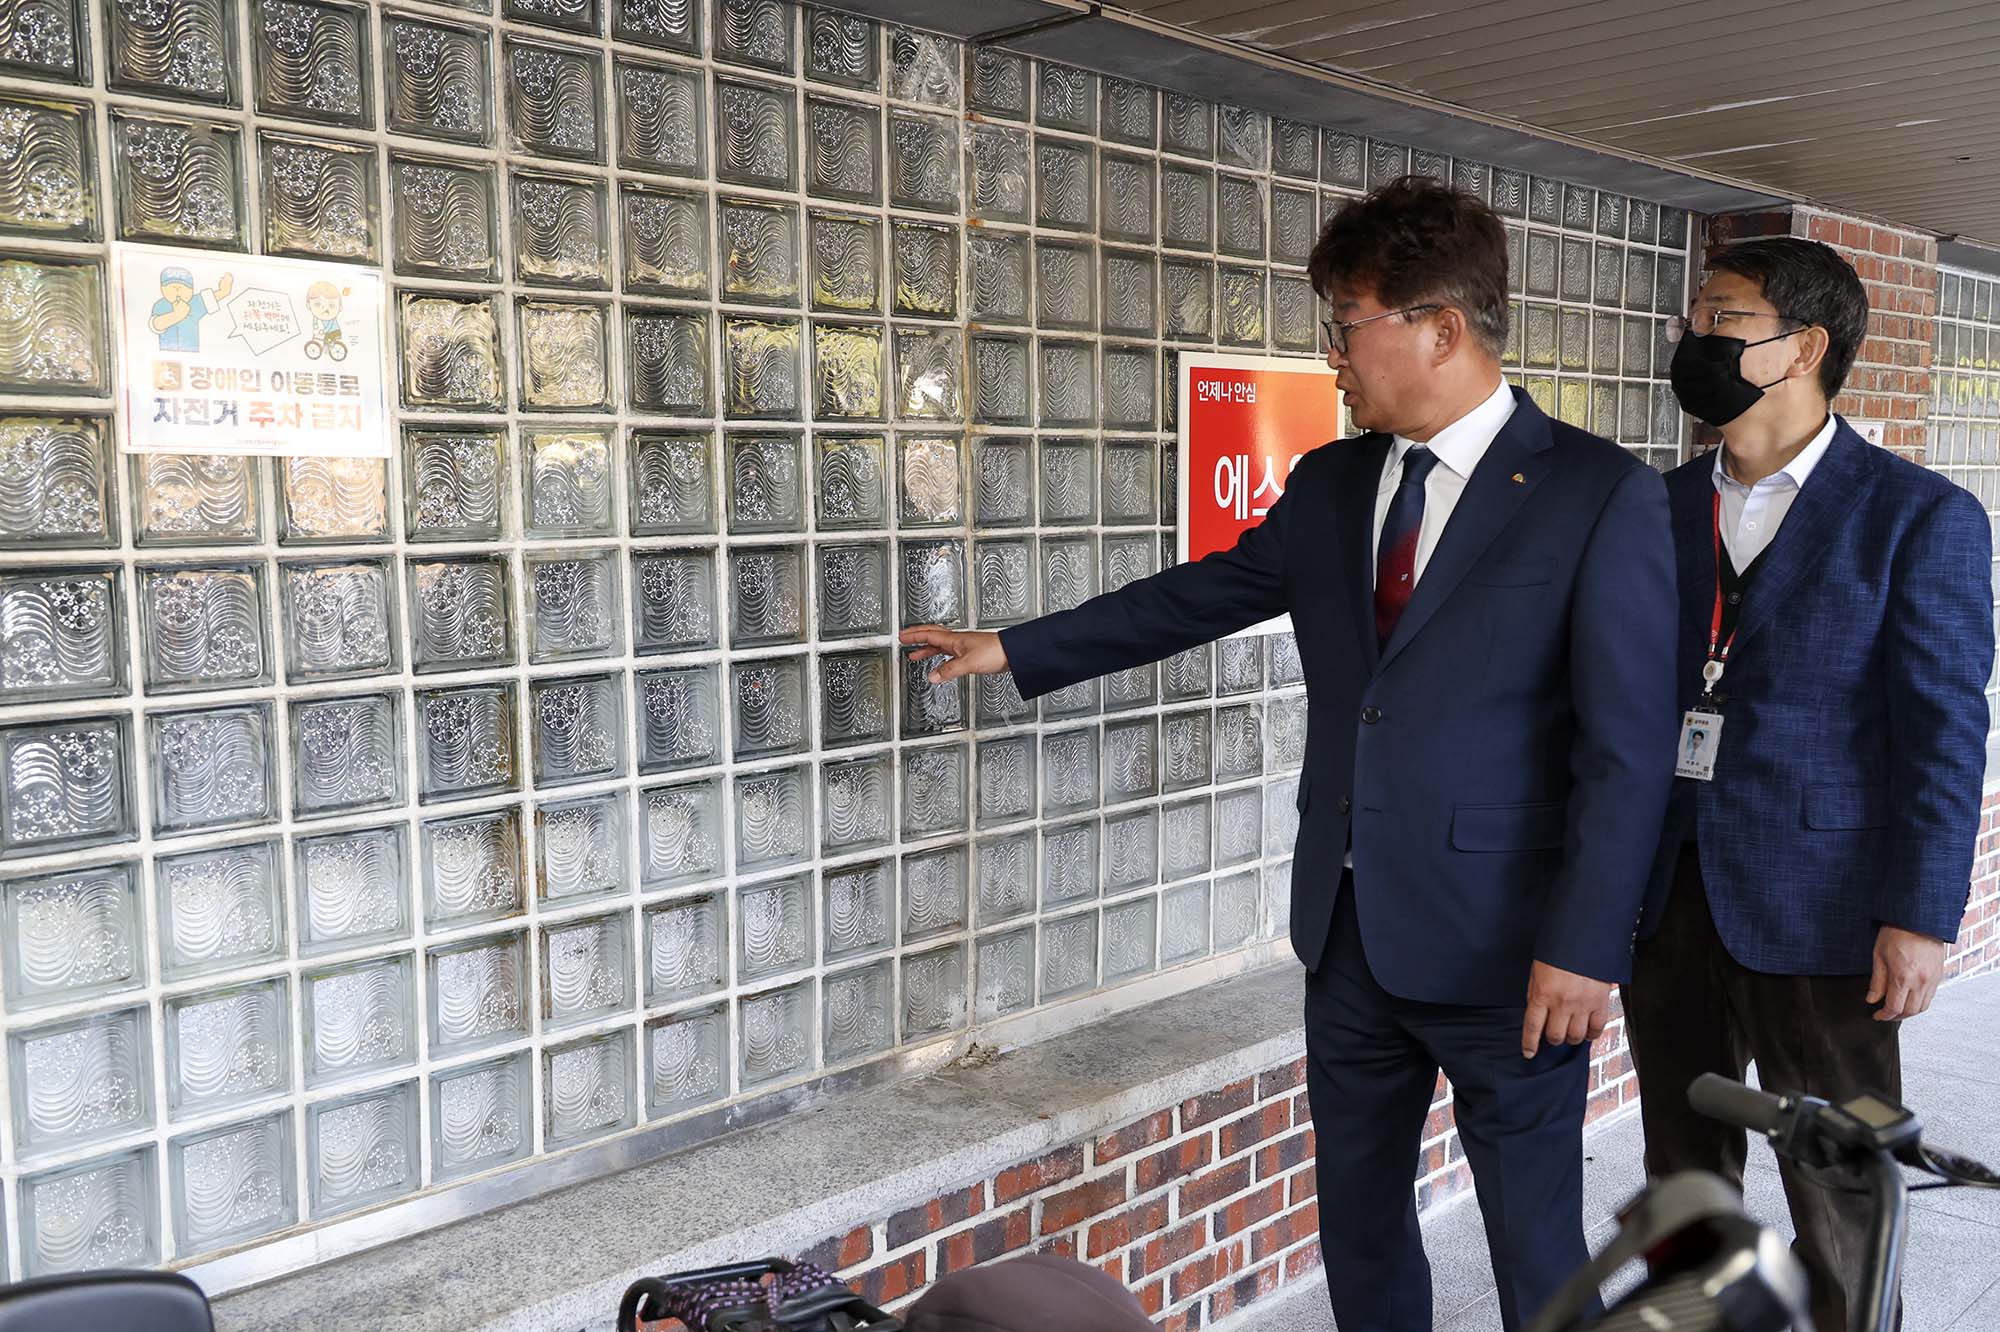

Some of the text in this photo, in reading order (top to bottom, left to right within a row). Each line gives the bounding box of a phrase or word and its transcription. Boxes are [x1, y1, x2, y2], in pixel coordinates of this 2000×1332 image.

[189, 366, 361, 397] 장애인 이동통로
[1197, 380, 1256, 404] 언제나 안심
[153, 397, 363, 432] 자전거 주차 금지
[1214, 453, 1304, 520] 에스
